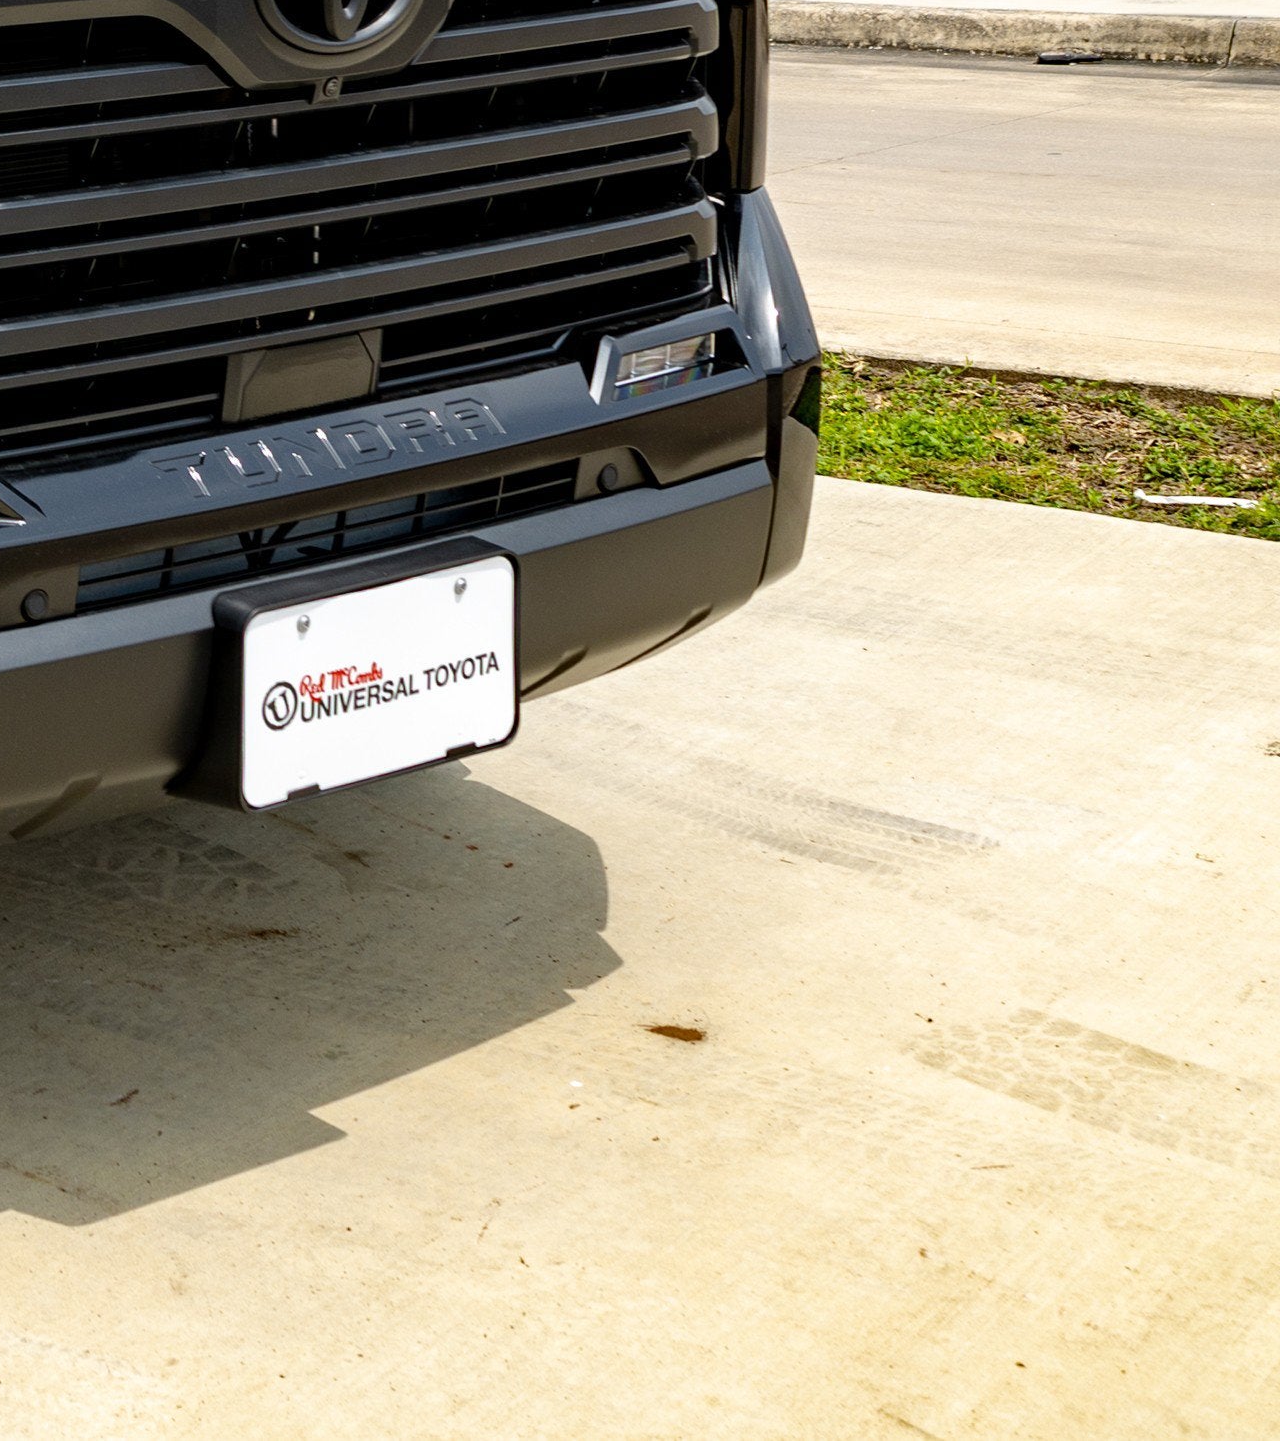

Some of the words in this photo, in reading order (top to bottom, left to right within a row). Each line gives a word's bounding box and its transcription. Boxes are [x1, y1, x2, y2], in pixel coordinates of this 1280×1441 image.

[149, 396, 507, 498] TUNDRA
[299, 673, 327, 703] Red
[300, 673, 420, 723] UNIVERSAL
[423, 651, 500, 691] TOYOTA
